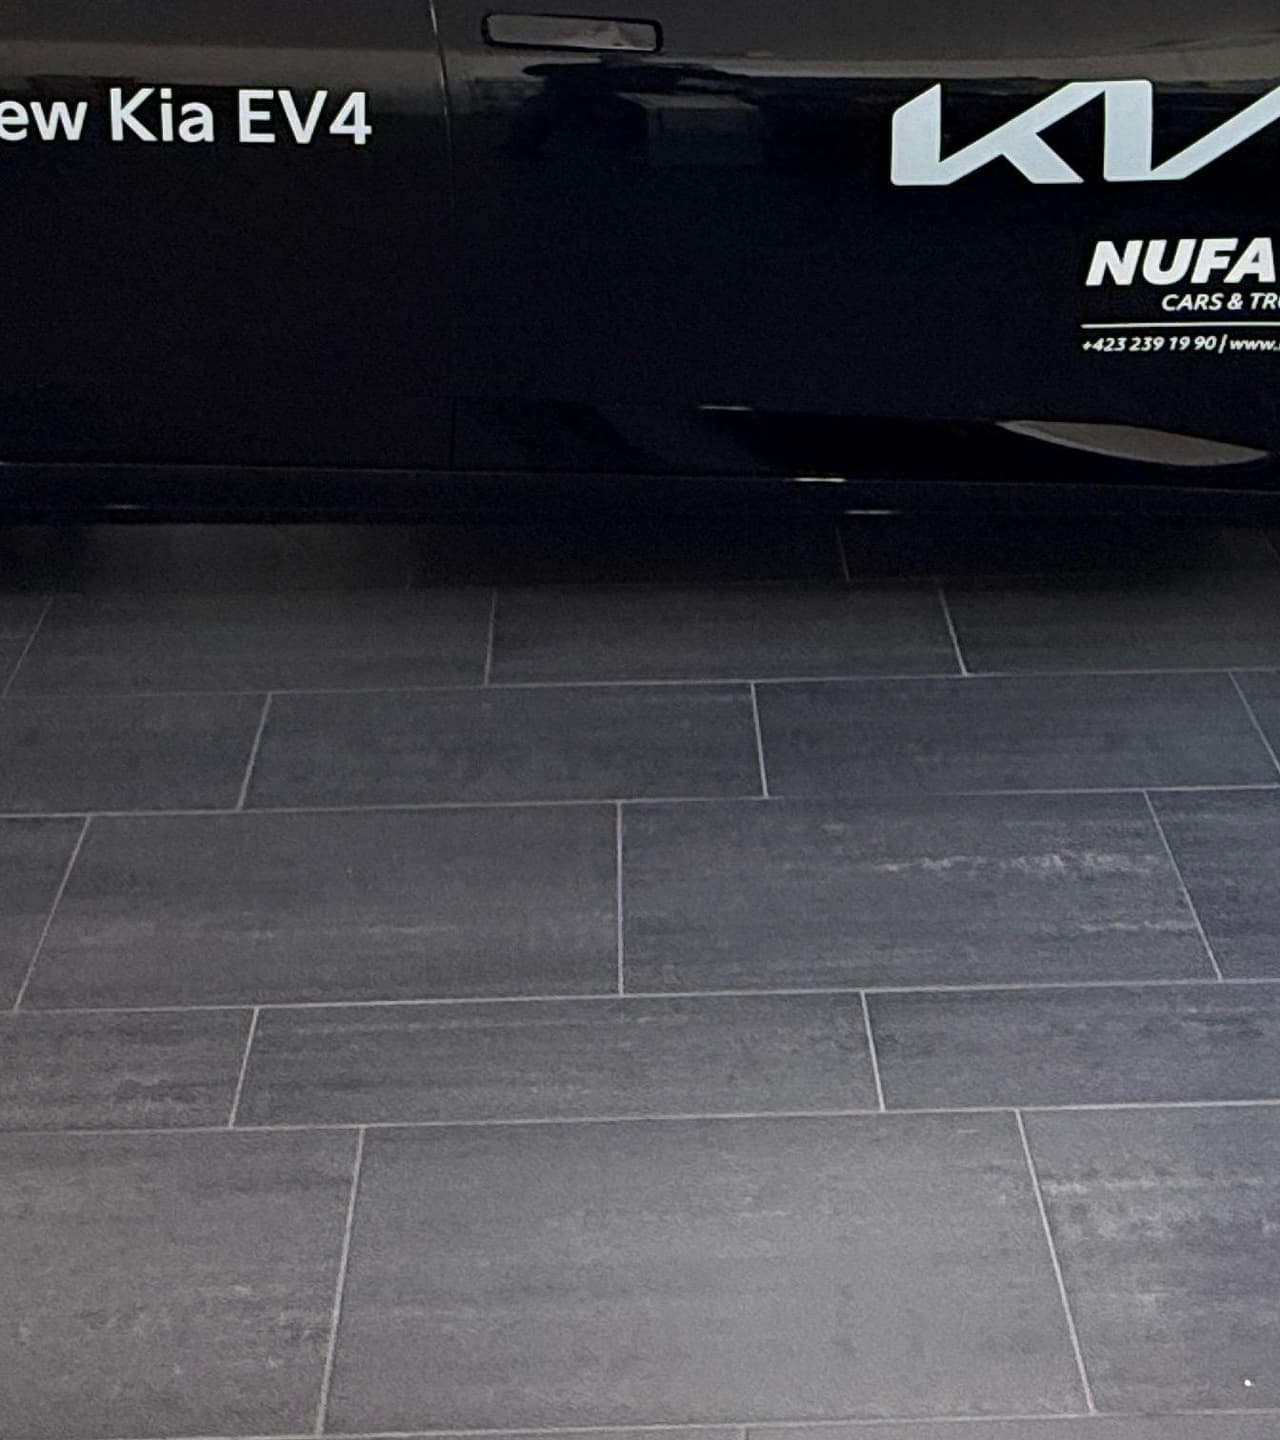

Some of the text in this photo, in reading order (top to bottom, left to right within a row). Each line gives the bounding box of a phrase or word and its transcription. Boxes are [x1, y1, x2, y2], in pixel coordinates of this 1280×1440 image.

[109, 87, 214, 142] Kia
[238, 89, 372, 145] EV4
[1085, 237, 1276, 286] NUFA
[1161, 292, 1225, 312] CARS
[1226, 292, 1244, 311] &
[1082, 336, 1127, 352] +423
[1128, 336, 1165, 352] 239
[1169, 336, 1191, 351] 19
[1193, 335, 1218, 351] 90
